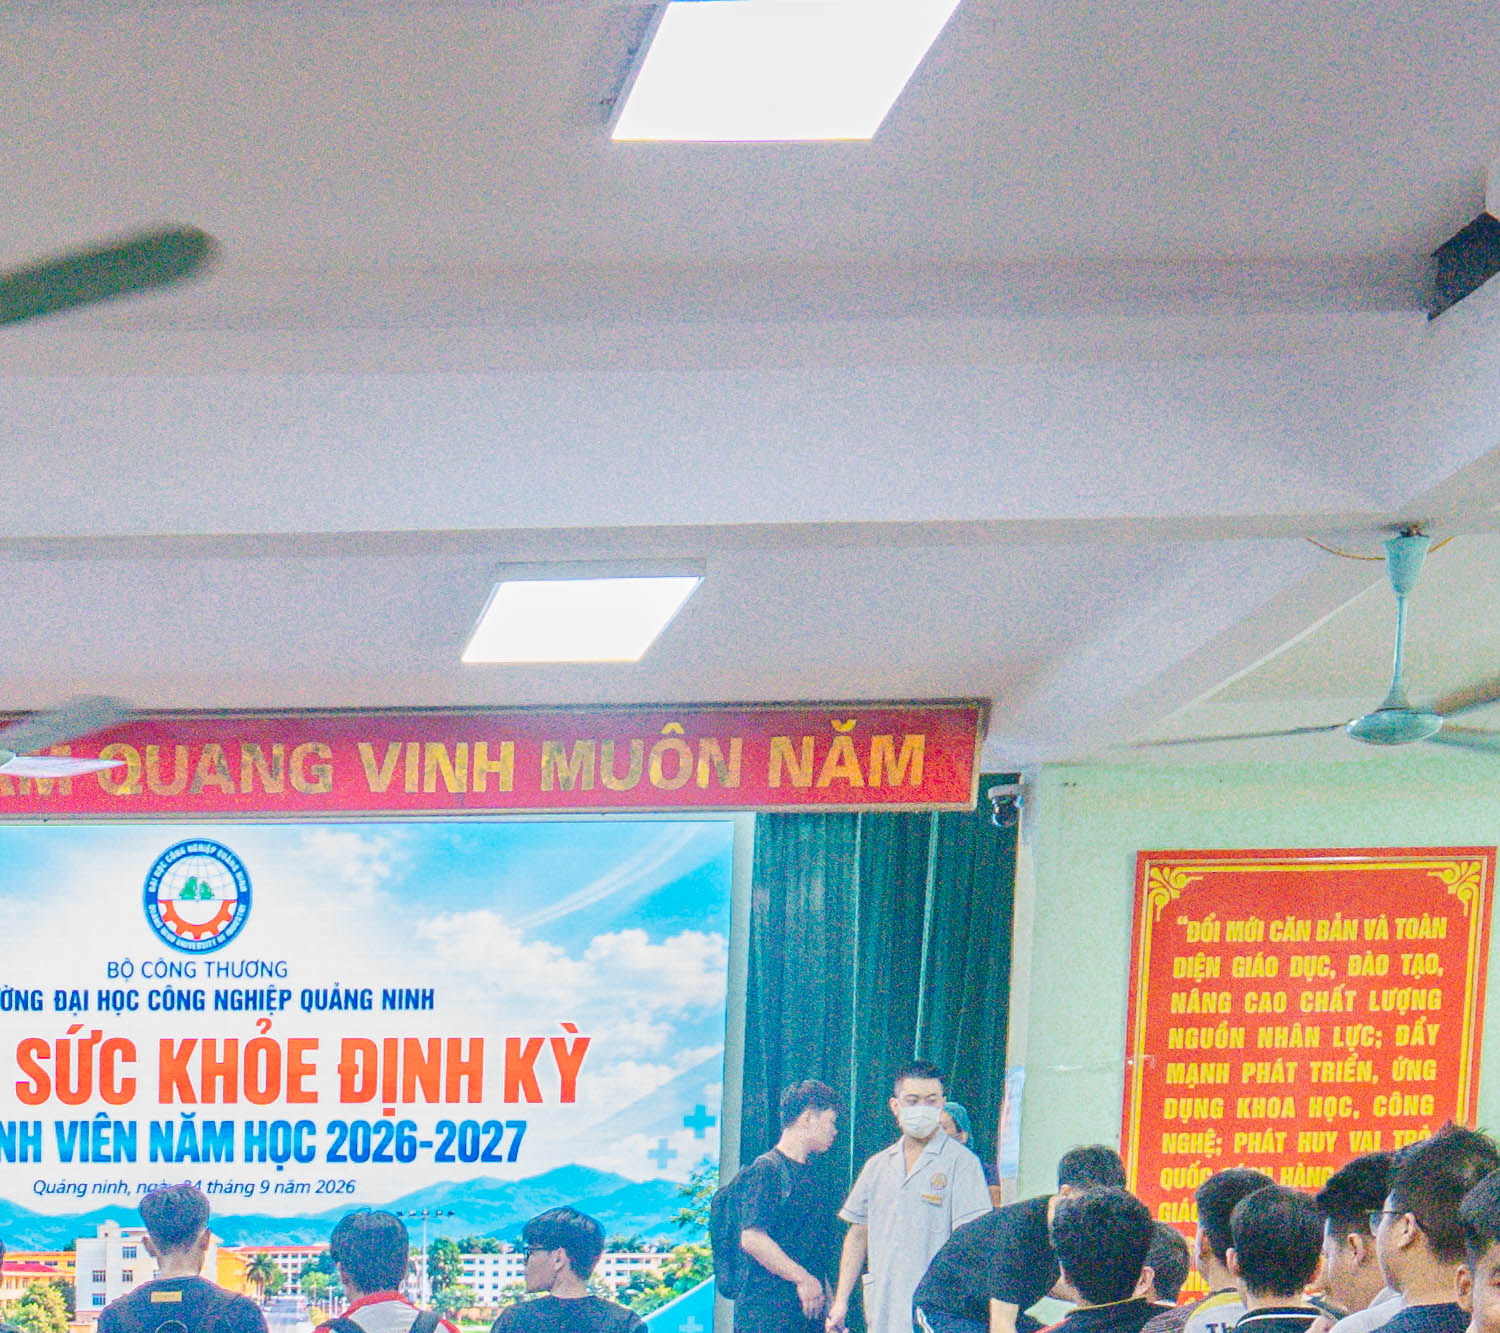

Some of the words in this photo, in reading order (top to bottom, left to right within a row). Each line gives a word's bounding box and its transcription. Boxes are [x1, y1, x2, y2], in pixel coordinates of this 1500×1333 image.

[96, 741, 334, 797] QUANG
[357, 741, 514, 794] VINH
[540, 722, 740, 792] MUÔN
[768, 719, 926, 789] NĂM
[1270, 917, 1311, 941] CĂN
[1396, 914, 1447, 939] TOÀN
[108, 957, 134, 982] BỘ
[142, 957, 196, 979] CÔNG
[205, 959, 287, 979] THƯƠNG
[1174, 953, 1220, 981] DIỆN
[1232, 952, 1278, 977] GIÁO
[1290, 956, 1335, 980] DỤC,
[1349, 952, 1389, 975] ĐÀO
[54, 990, 88, 1016] ĐẠI
[98, 990, 138, 1016] HỌC
[148, 986, 205, 1011] CÔNG
[214, 985, 291, 1015] NGHIỆP
[301, 981, 372, 1012] QUẢNG
[382, 989, 434, 1010] NINH
[1172, 989, 1231, 1013] NÂNG
[1301, 987, 1355, 1011] CHẤT
[1370, 988, 1441, 1014] LƯỢNG
[16, 1025, 136, 1105] SỨC
[159, 1019, 318, 1105] KHỎE
[338, 1038, 483, 1116] ĐỊNH
[504, 1023, 589, 1103] KỲ
[1166, 1062, 1229, 1088] MẠNH
[1242, 1059, 1297, 1082] PHÁT
[1311, 1055, 1378, 1083] TRIỂN,
[1237, 1097, 1295, 1118] KHOA
[1374, 1091, 1434, 1116] CÔNG
[54, 1112, 137, 1163] VIÊN
[149, 1112, 234, 1163] NĂM
[244, 1120, 316, 1171] HỌC
[326, 1120, 527, 1163] 2026-2027
[1235, 1128, 1286, 1152] PHÁT
[1298, 1131, 1338, 1152] HUY
[33, 1178, 88, 1196] Quảng
[92, 1180, 131, 1196] ninh,
[207, 1179, 254, 1196] tháng
[259, 1180, 270, 1194] 9
[274, 1180, 311, 1194] năm
[316, 1180, 356, 1194] 2026
